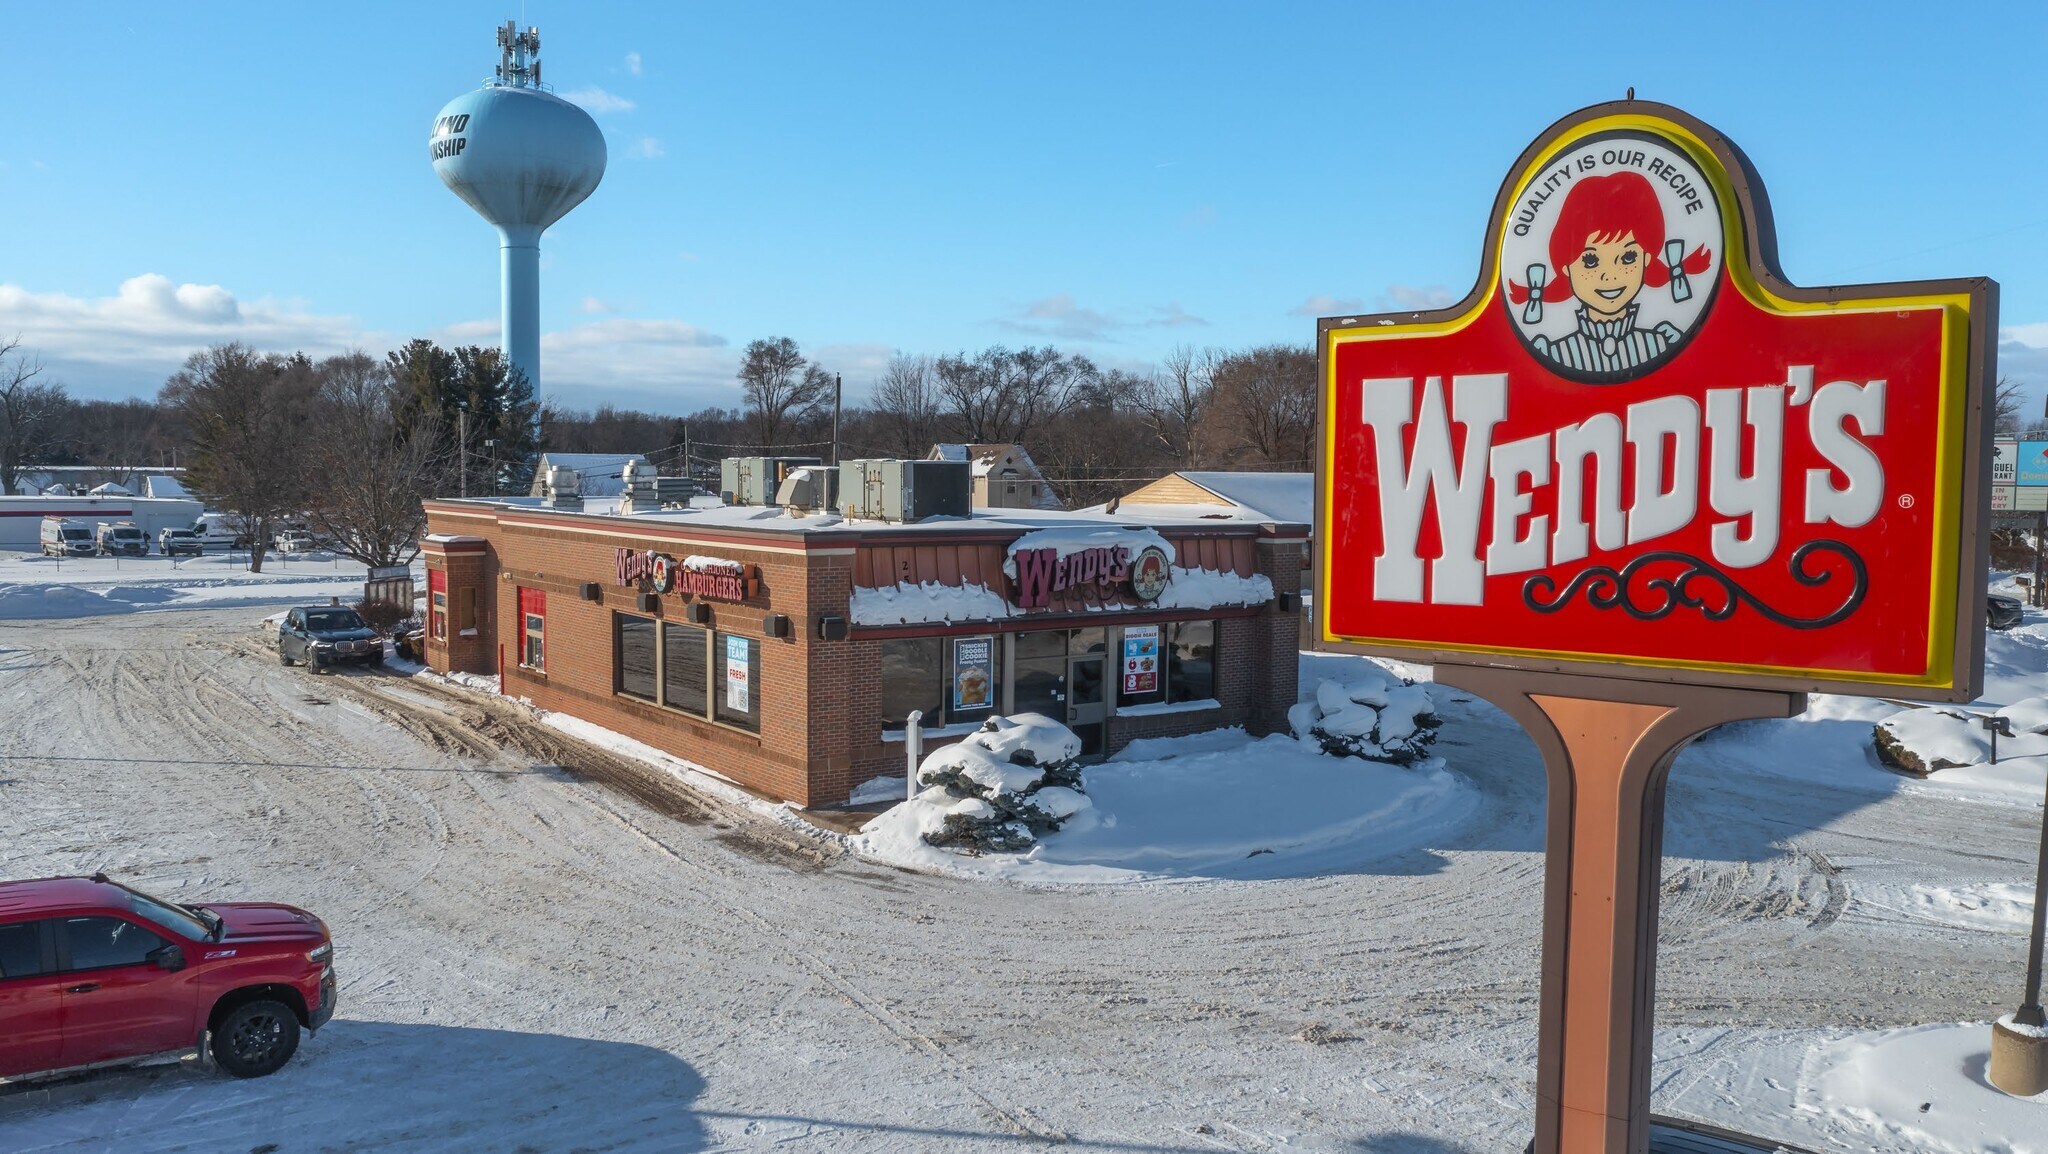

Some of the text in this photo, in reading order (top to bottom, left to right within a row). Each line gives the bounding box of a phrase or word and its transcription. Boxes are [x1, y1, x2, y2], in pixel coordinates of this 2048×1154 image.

[1513, 150, 1704, 237] QUALITY IS OUR RECIPE
[1362, 364, 1887, 607] Wendy's
[615, 548, 653, 586] Wendys
[675, 570, 743, 601] HAMBURGERS
[1016, 544, 1129, 608] Wendy's
[729, 668, 746, 681] FRESH
